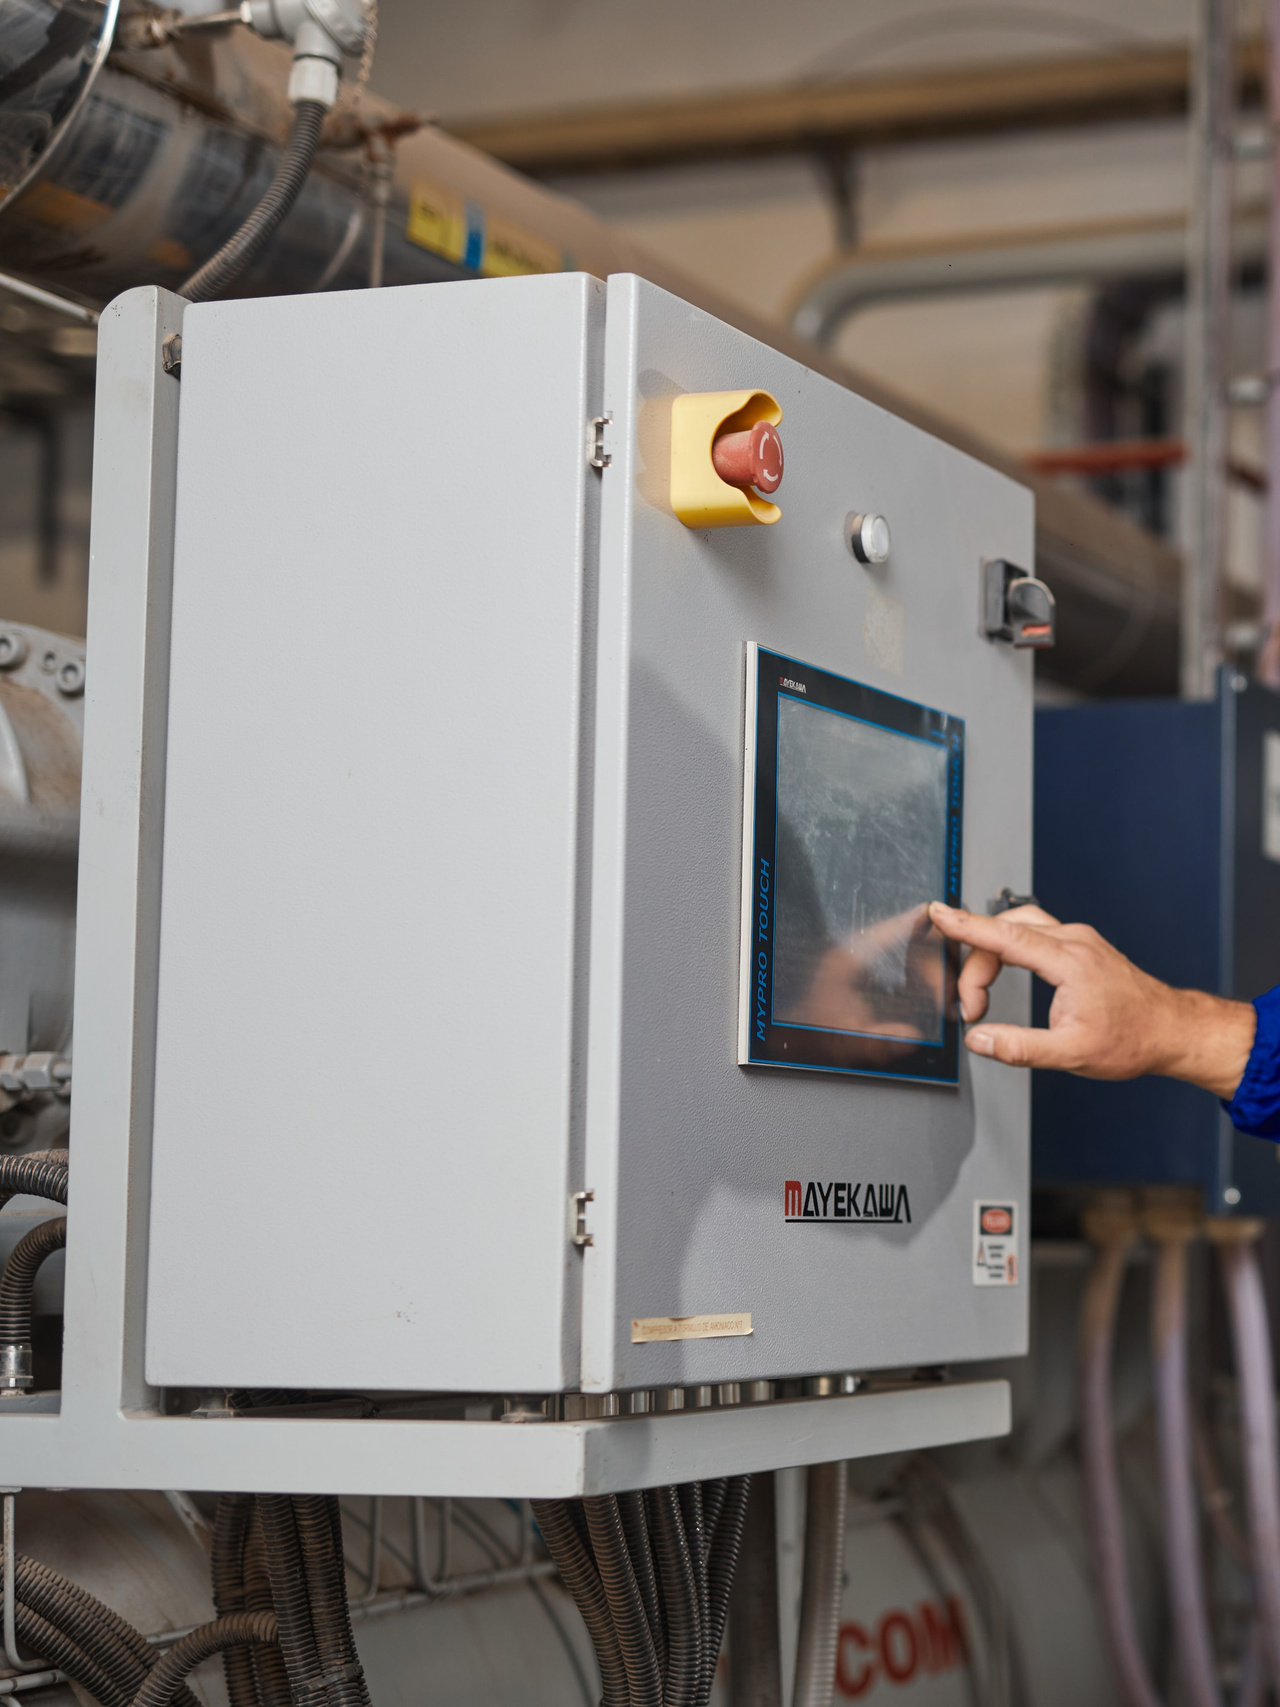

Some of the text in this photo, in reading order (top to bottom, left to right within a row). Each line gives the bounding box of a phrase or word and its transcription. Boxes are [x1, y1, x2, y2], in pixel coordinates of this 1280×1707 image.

[756, 857, 770, 1042] MYPRO TOUCH
[784, 1180, 912, 1223] MAYEKAWA
[701, 1321, 709, 1332] DE
